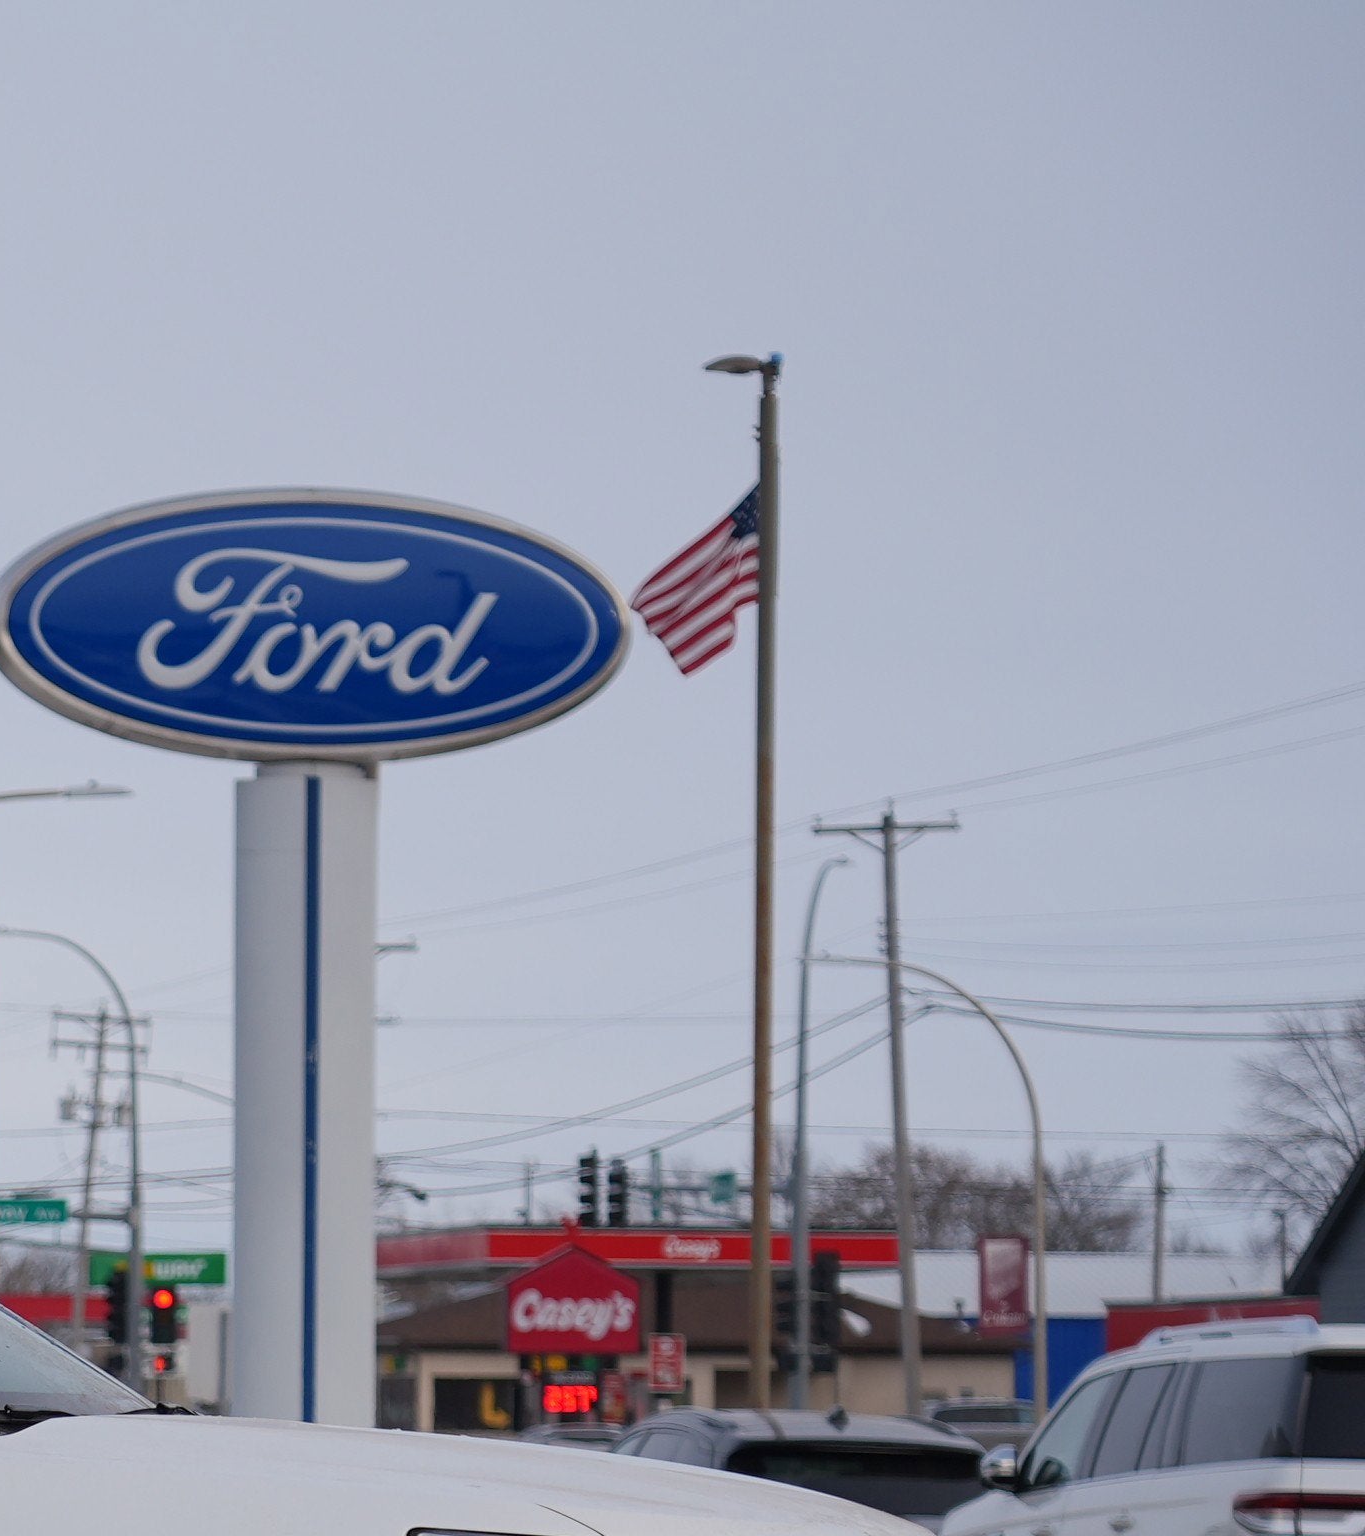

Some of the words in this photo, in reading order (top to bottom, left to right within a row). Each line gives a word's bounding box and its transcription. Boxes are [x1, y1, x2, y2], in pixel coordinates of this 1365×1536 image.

[135, 546, 498, 695] Ford
[113, 1258, 209, 1282] BWAY
[511, 1287, 636, 1341] Casey's
